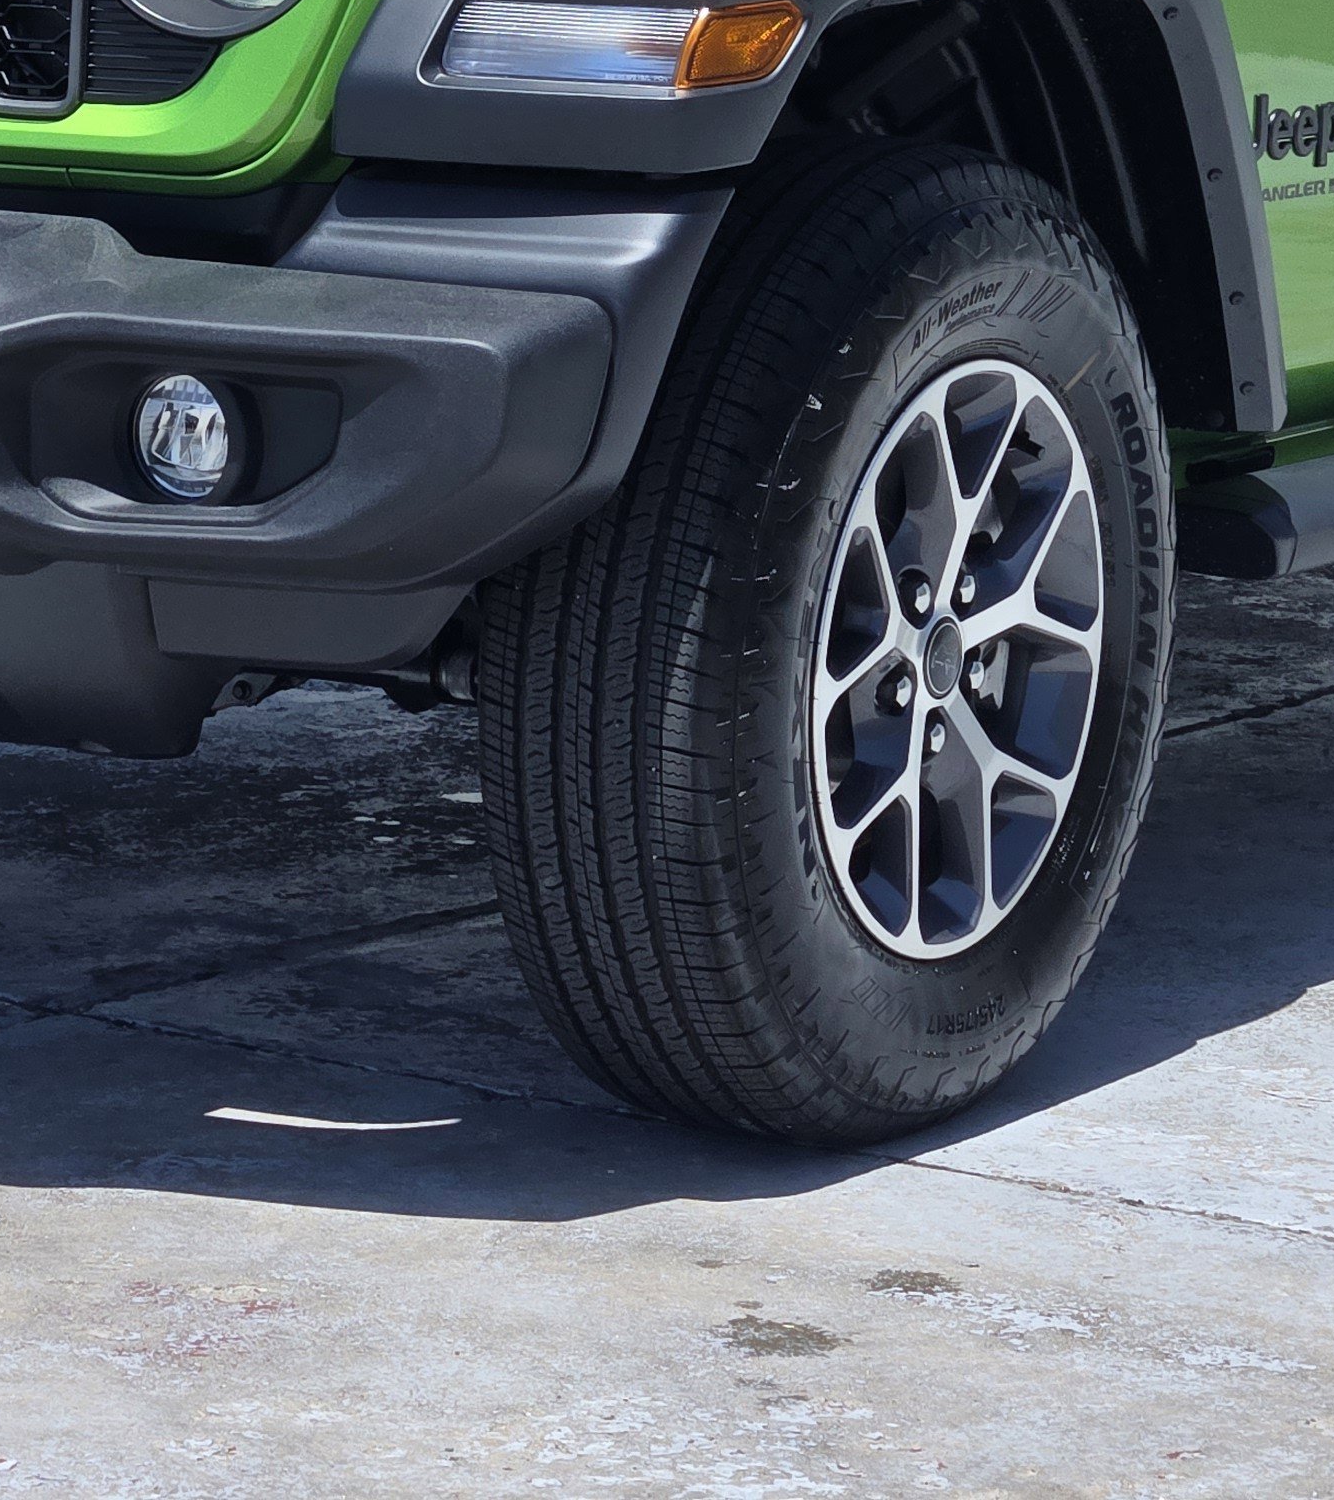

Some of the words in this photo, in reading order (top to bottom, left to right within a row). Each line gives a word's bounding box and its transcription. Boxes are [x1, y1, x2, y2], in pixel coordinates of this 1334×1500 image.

[1262, 180, 1326, 202] ANGLER
[909, 280, 1003, 353] All-Weather
[1110, 391, 1160, 669] ROADIAN
